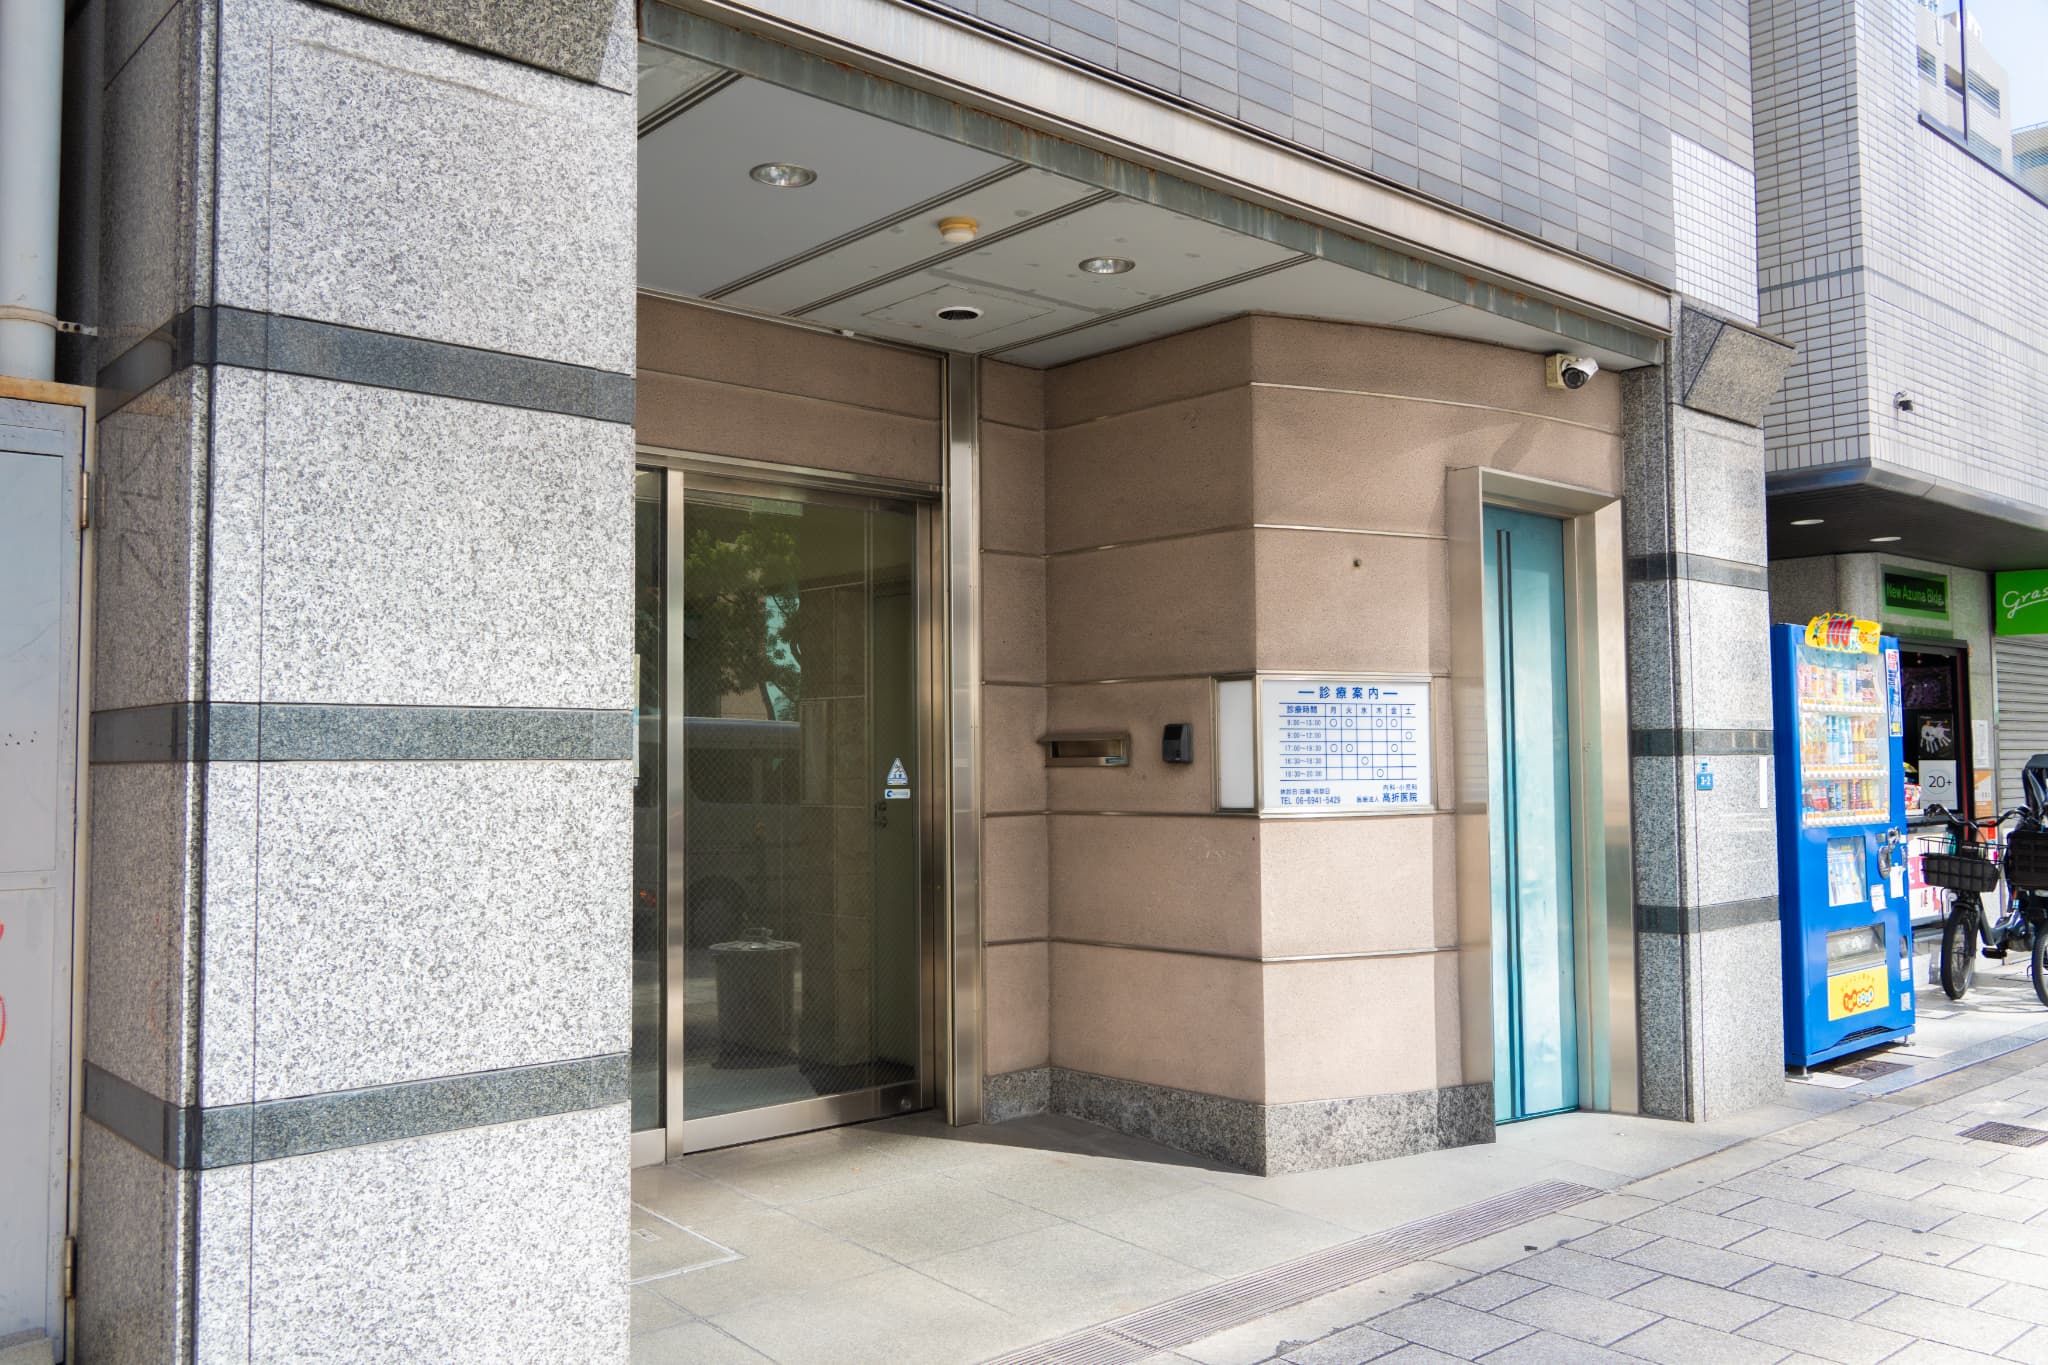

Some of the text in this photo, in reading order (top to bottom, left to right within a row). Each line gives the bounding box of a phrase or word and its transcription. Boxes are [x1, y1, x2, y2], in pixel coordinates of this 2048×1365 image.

[1286, 705, 1318, 714] 診療時間
[1330, 706, 1337, 714] 月
[1346, 706, 1352, 714] 火
[1361, 706, 1368, 714] 水
[1391, 706, 1398, 715] 金
[1406, 707, 1413, 715] 土
[1928, 775, 1952, 788] 20+
[1280, 796, 1292, 805] TEL
[1382, 792, 1418, 802] 高折医院
